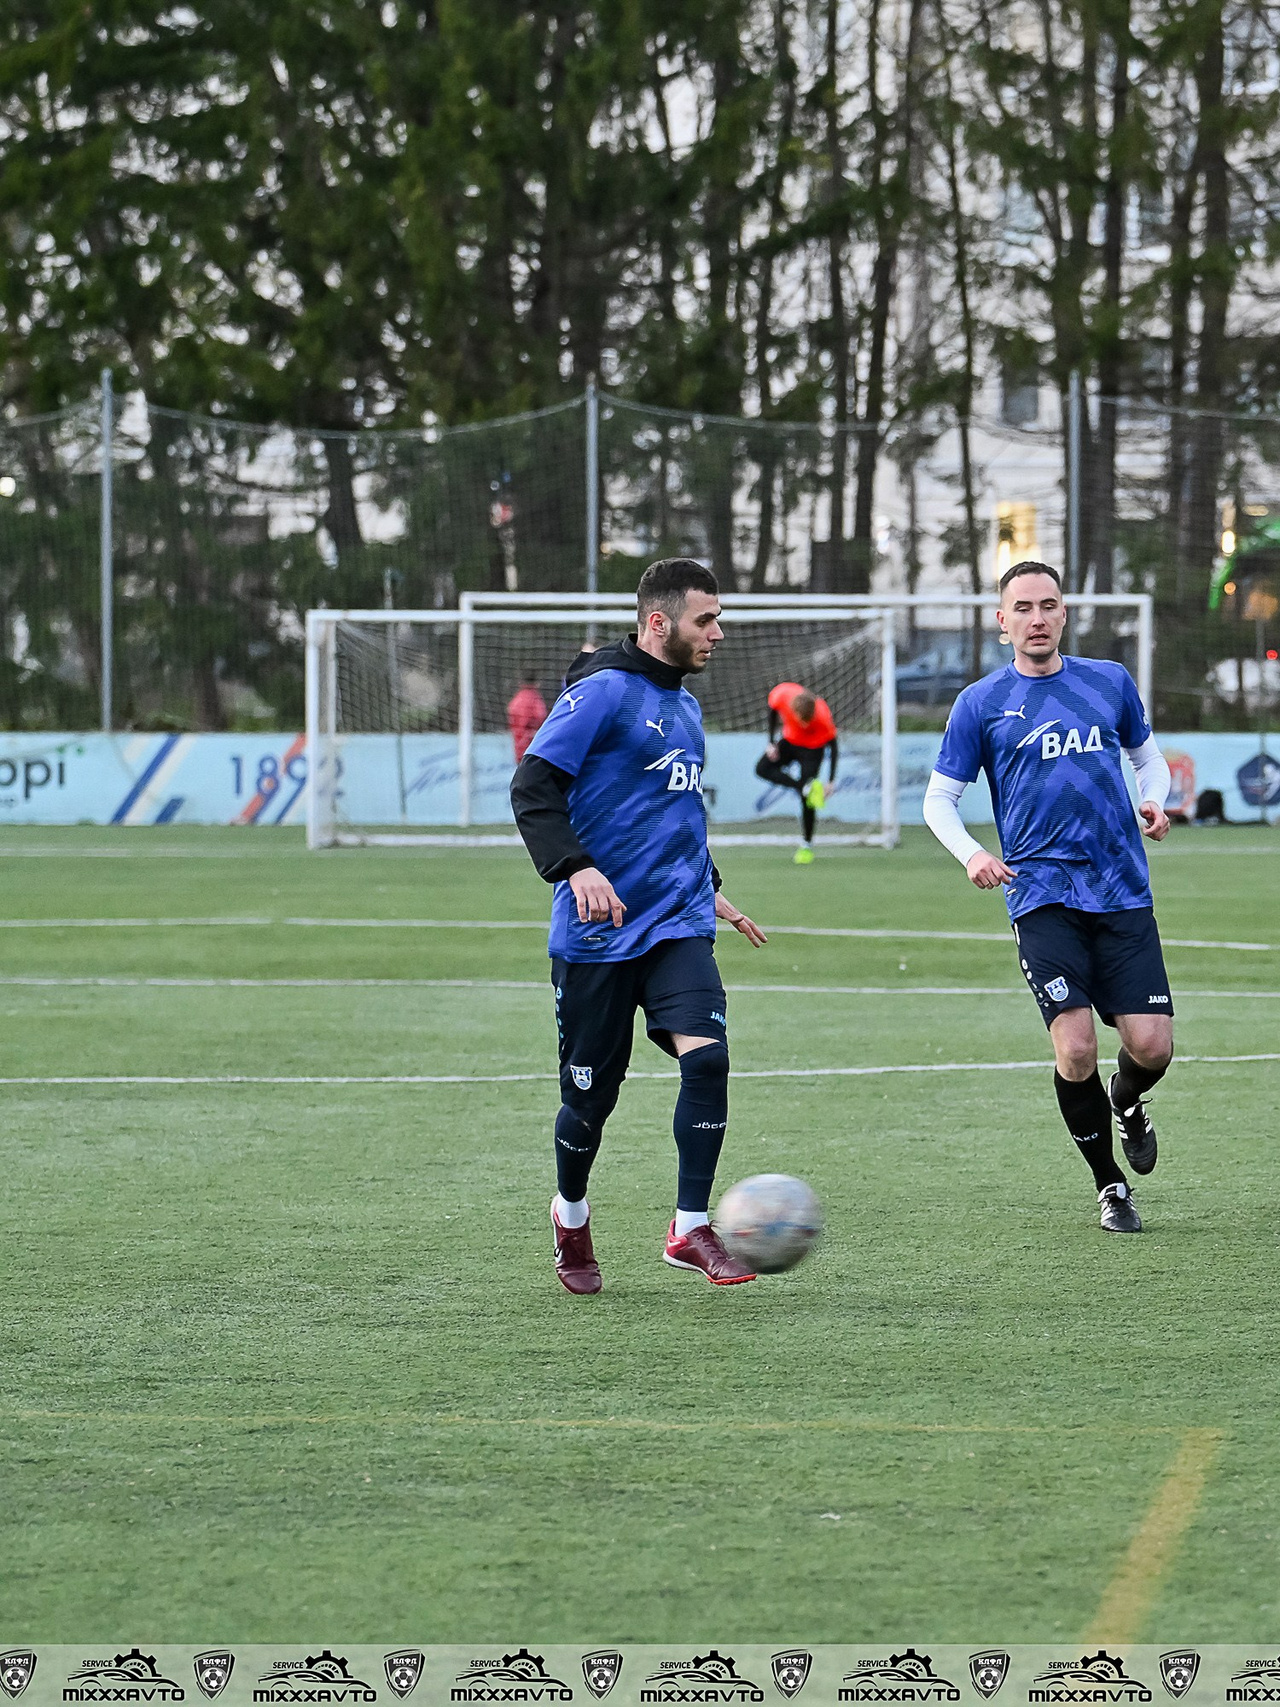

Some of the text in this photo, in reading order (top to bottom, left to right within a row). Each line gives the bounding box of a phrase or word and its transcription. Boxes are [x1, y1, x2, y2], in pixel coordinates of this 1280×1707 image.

[1041, 726, 1103, 760] ВАД
[667, 762, 704, 795] ВА
[1148, 995, 1168, 1003] JAKO
